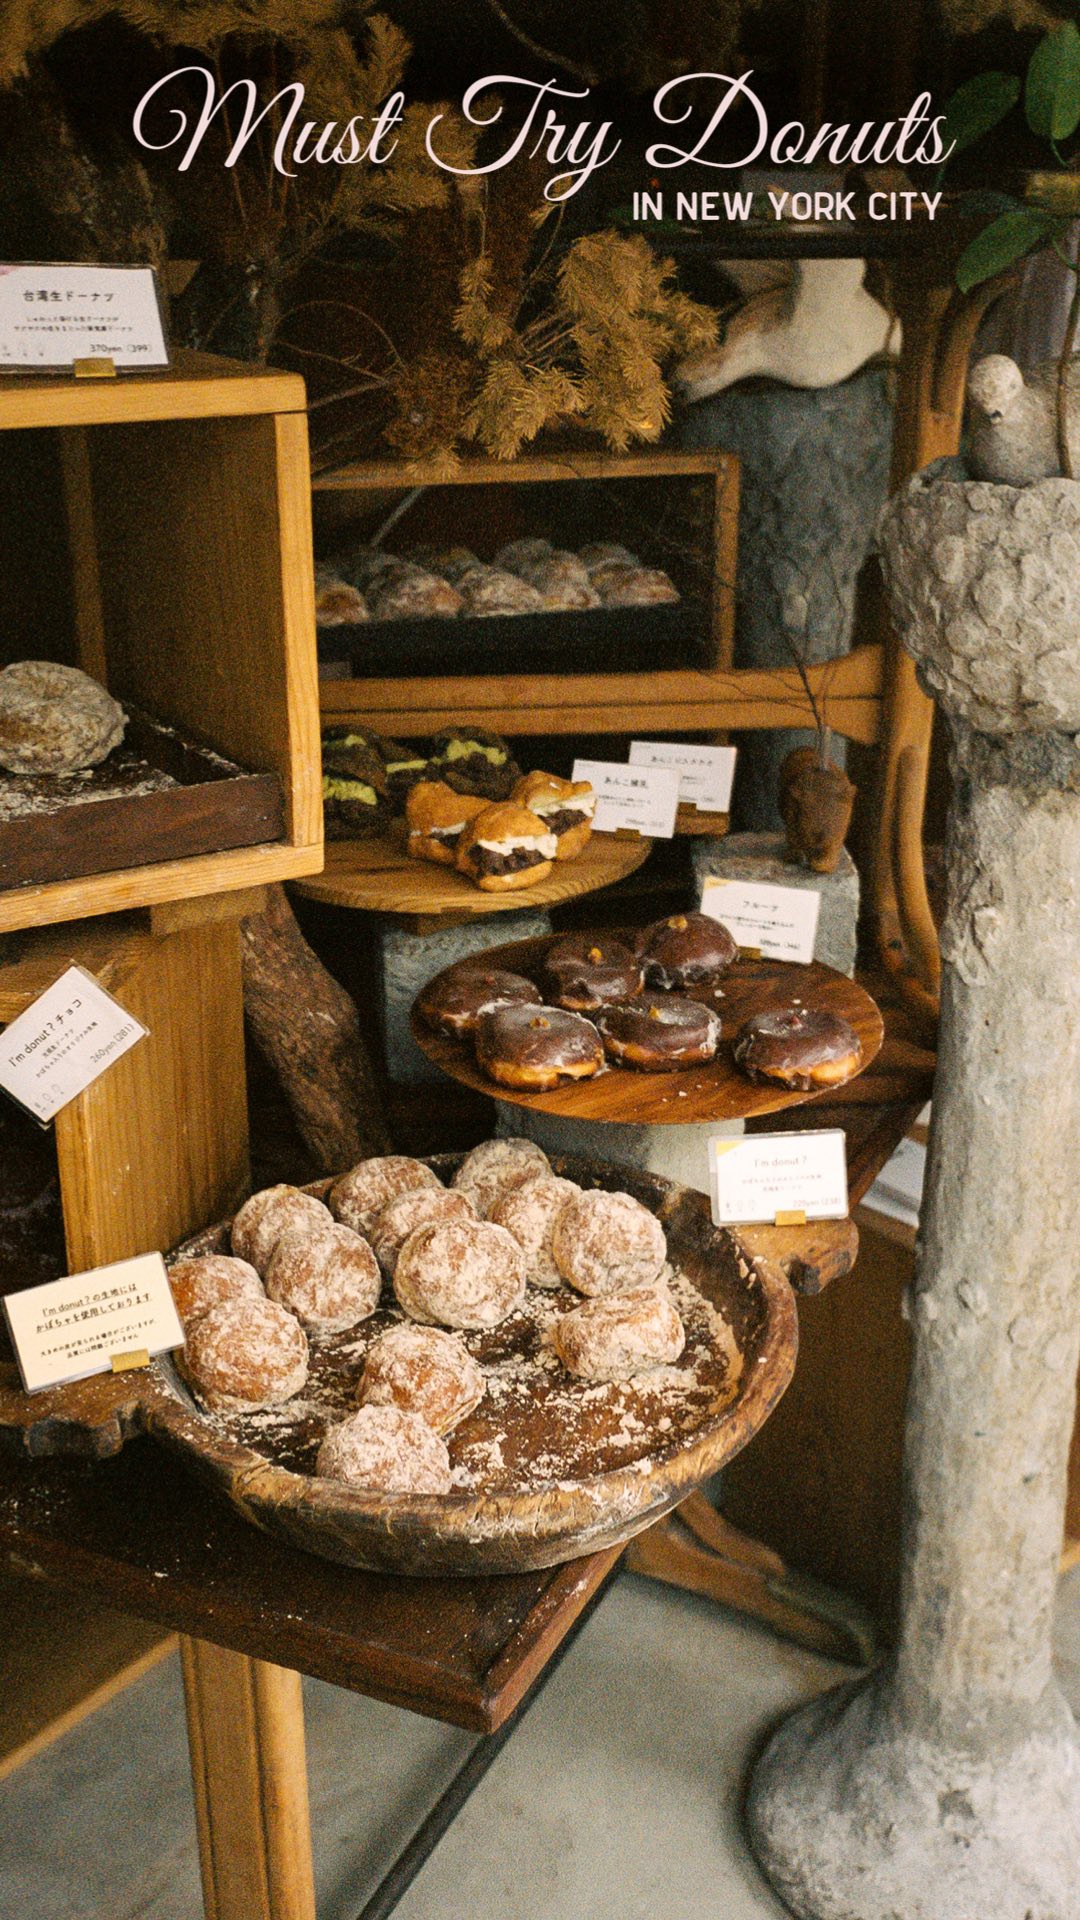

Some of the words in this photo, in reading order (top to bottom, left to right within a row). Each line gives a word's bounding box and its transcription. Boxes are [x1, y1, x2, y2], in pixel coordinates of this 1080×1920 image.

[8, 1053, 26, 1068] I'm
[24, 1029, 51, 1054] donut
[36, 1292, 151, 1333] かぼちゃを使用しております
